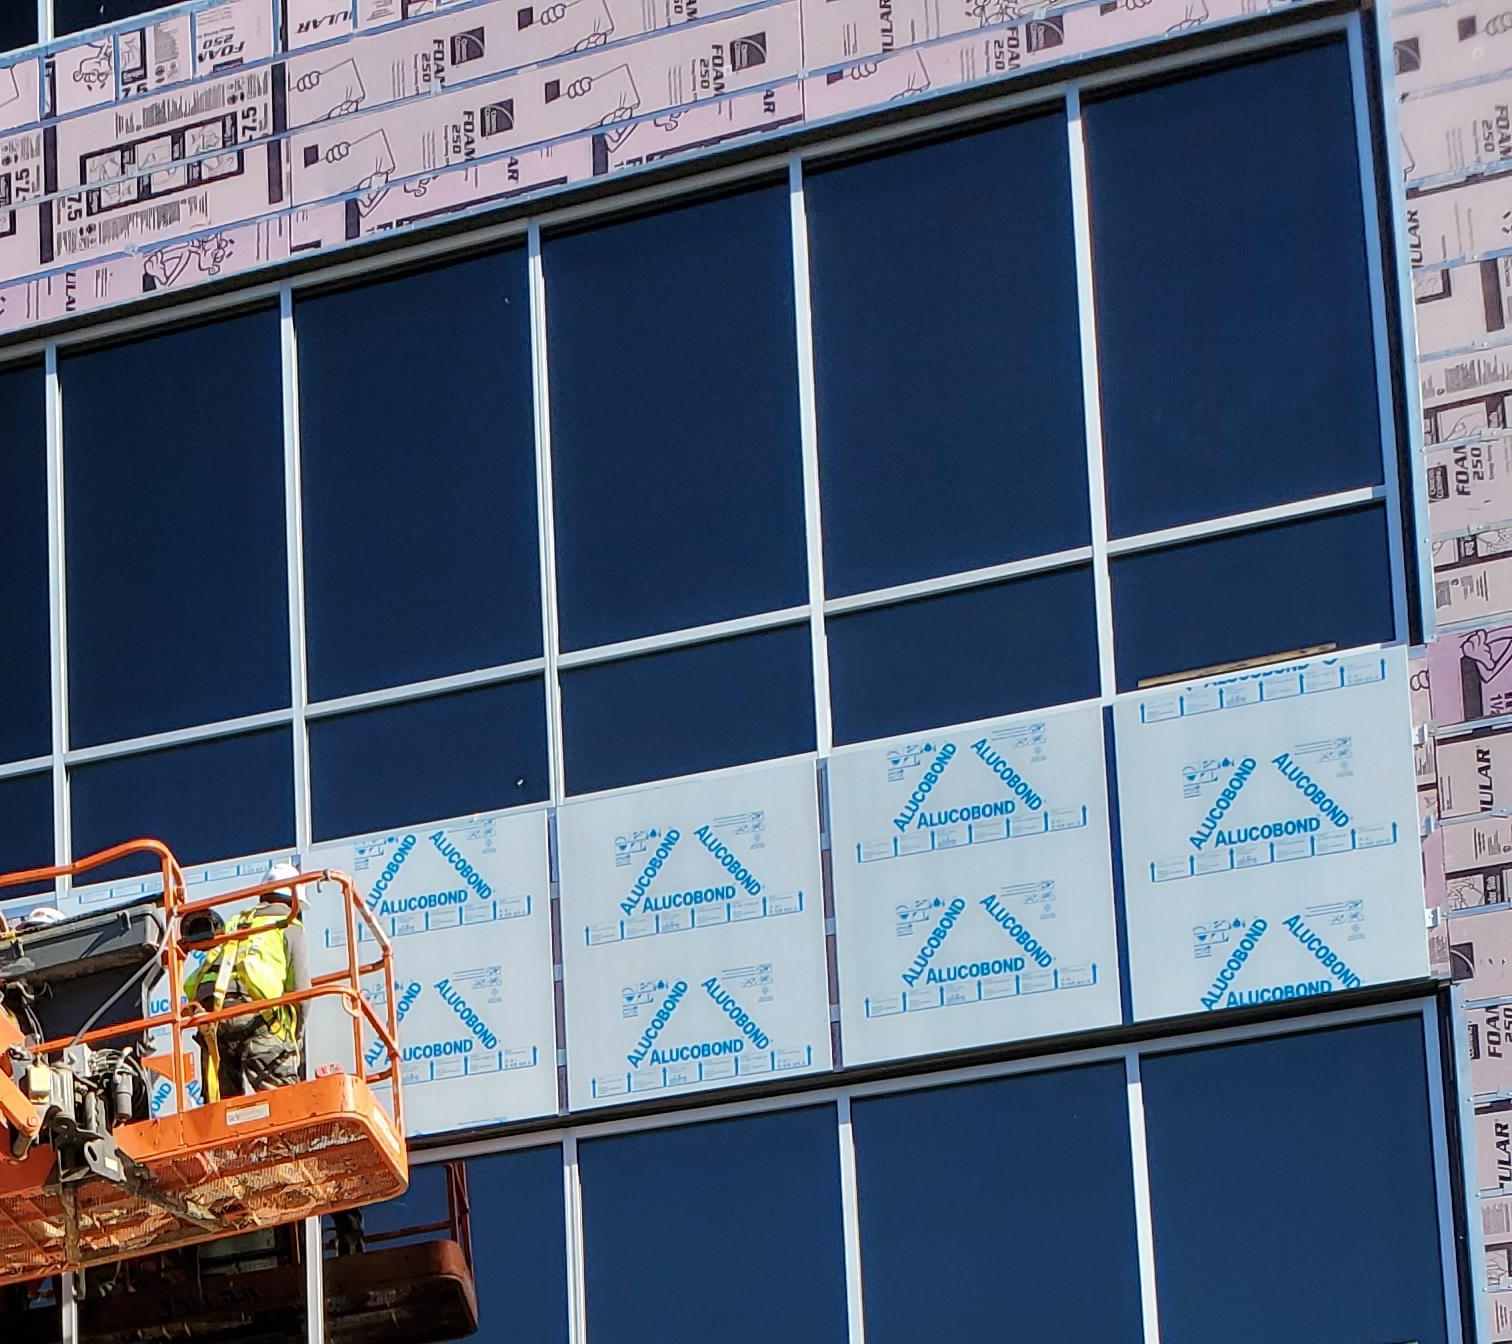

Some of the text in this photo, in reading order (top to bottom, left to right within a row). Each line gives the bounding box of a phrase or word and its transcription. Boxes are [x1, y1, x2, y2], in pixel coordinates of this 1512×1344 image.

[894, 743, 956, 832] ALUCOBOND
[972, 740, 1042, 810] ALUCOBOND
[1190, 758, 1256, 850] ALUCOBOND
[1273, 754, 1349, 827] ALUCOBOND
[918, 800, 1015, 828] ALUCOBOND
[1216, 817, 1320, 847] ALUCOBOND
[367, 835, 416, 908] LUCOBOND
[430, 831, 491, 899] ALUCOBOND
[621, 830, 680, 915] ALUCOBOND
[695, 826, 761, 895] ALUCOBOND
[380, 890, 468, 915] ALUCOBOND
[643, 886, 736, 912] ALUCOBOND
[980, 895, 1052, 967] ALUCOBOND
[903, 899, 965, 987] ALUCOBOND
[927, 957, 1025, 984] ALUCOBOND
[1201, 919, 1267, 1014] ALUCOBOND
[435, 979, 497, 1049] ALUCOBOND
[627, 981, 687, 1067] ALUCOBOND
[702, 978, 769, 1049] ALUCOBOND
[1228, 980, 1335, 1009] ALUCOBOND
[650, 1039, 743, 1065] ALUCOBOND
